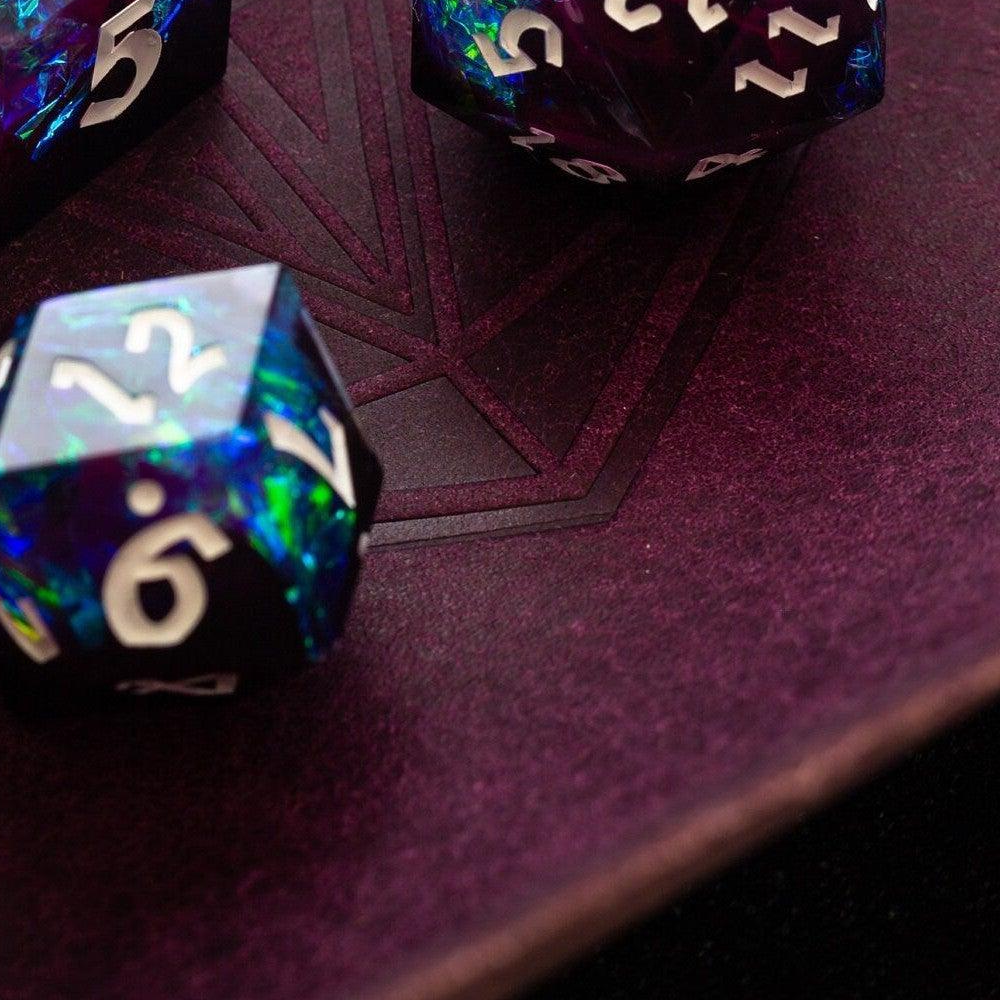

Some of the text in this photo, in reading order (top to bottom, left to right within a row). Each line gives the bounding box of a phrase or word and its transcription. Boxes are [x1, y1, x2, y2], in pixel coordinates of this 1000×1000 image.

[472, 7, 564, 79] 5
[734, 5, 842, 100] 11
[50, 305, 228, 426] 12
